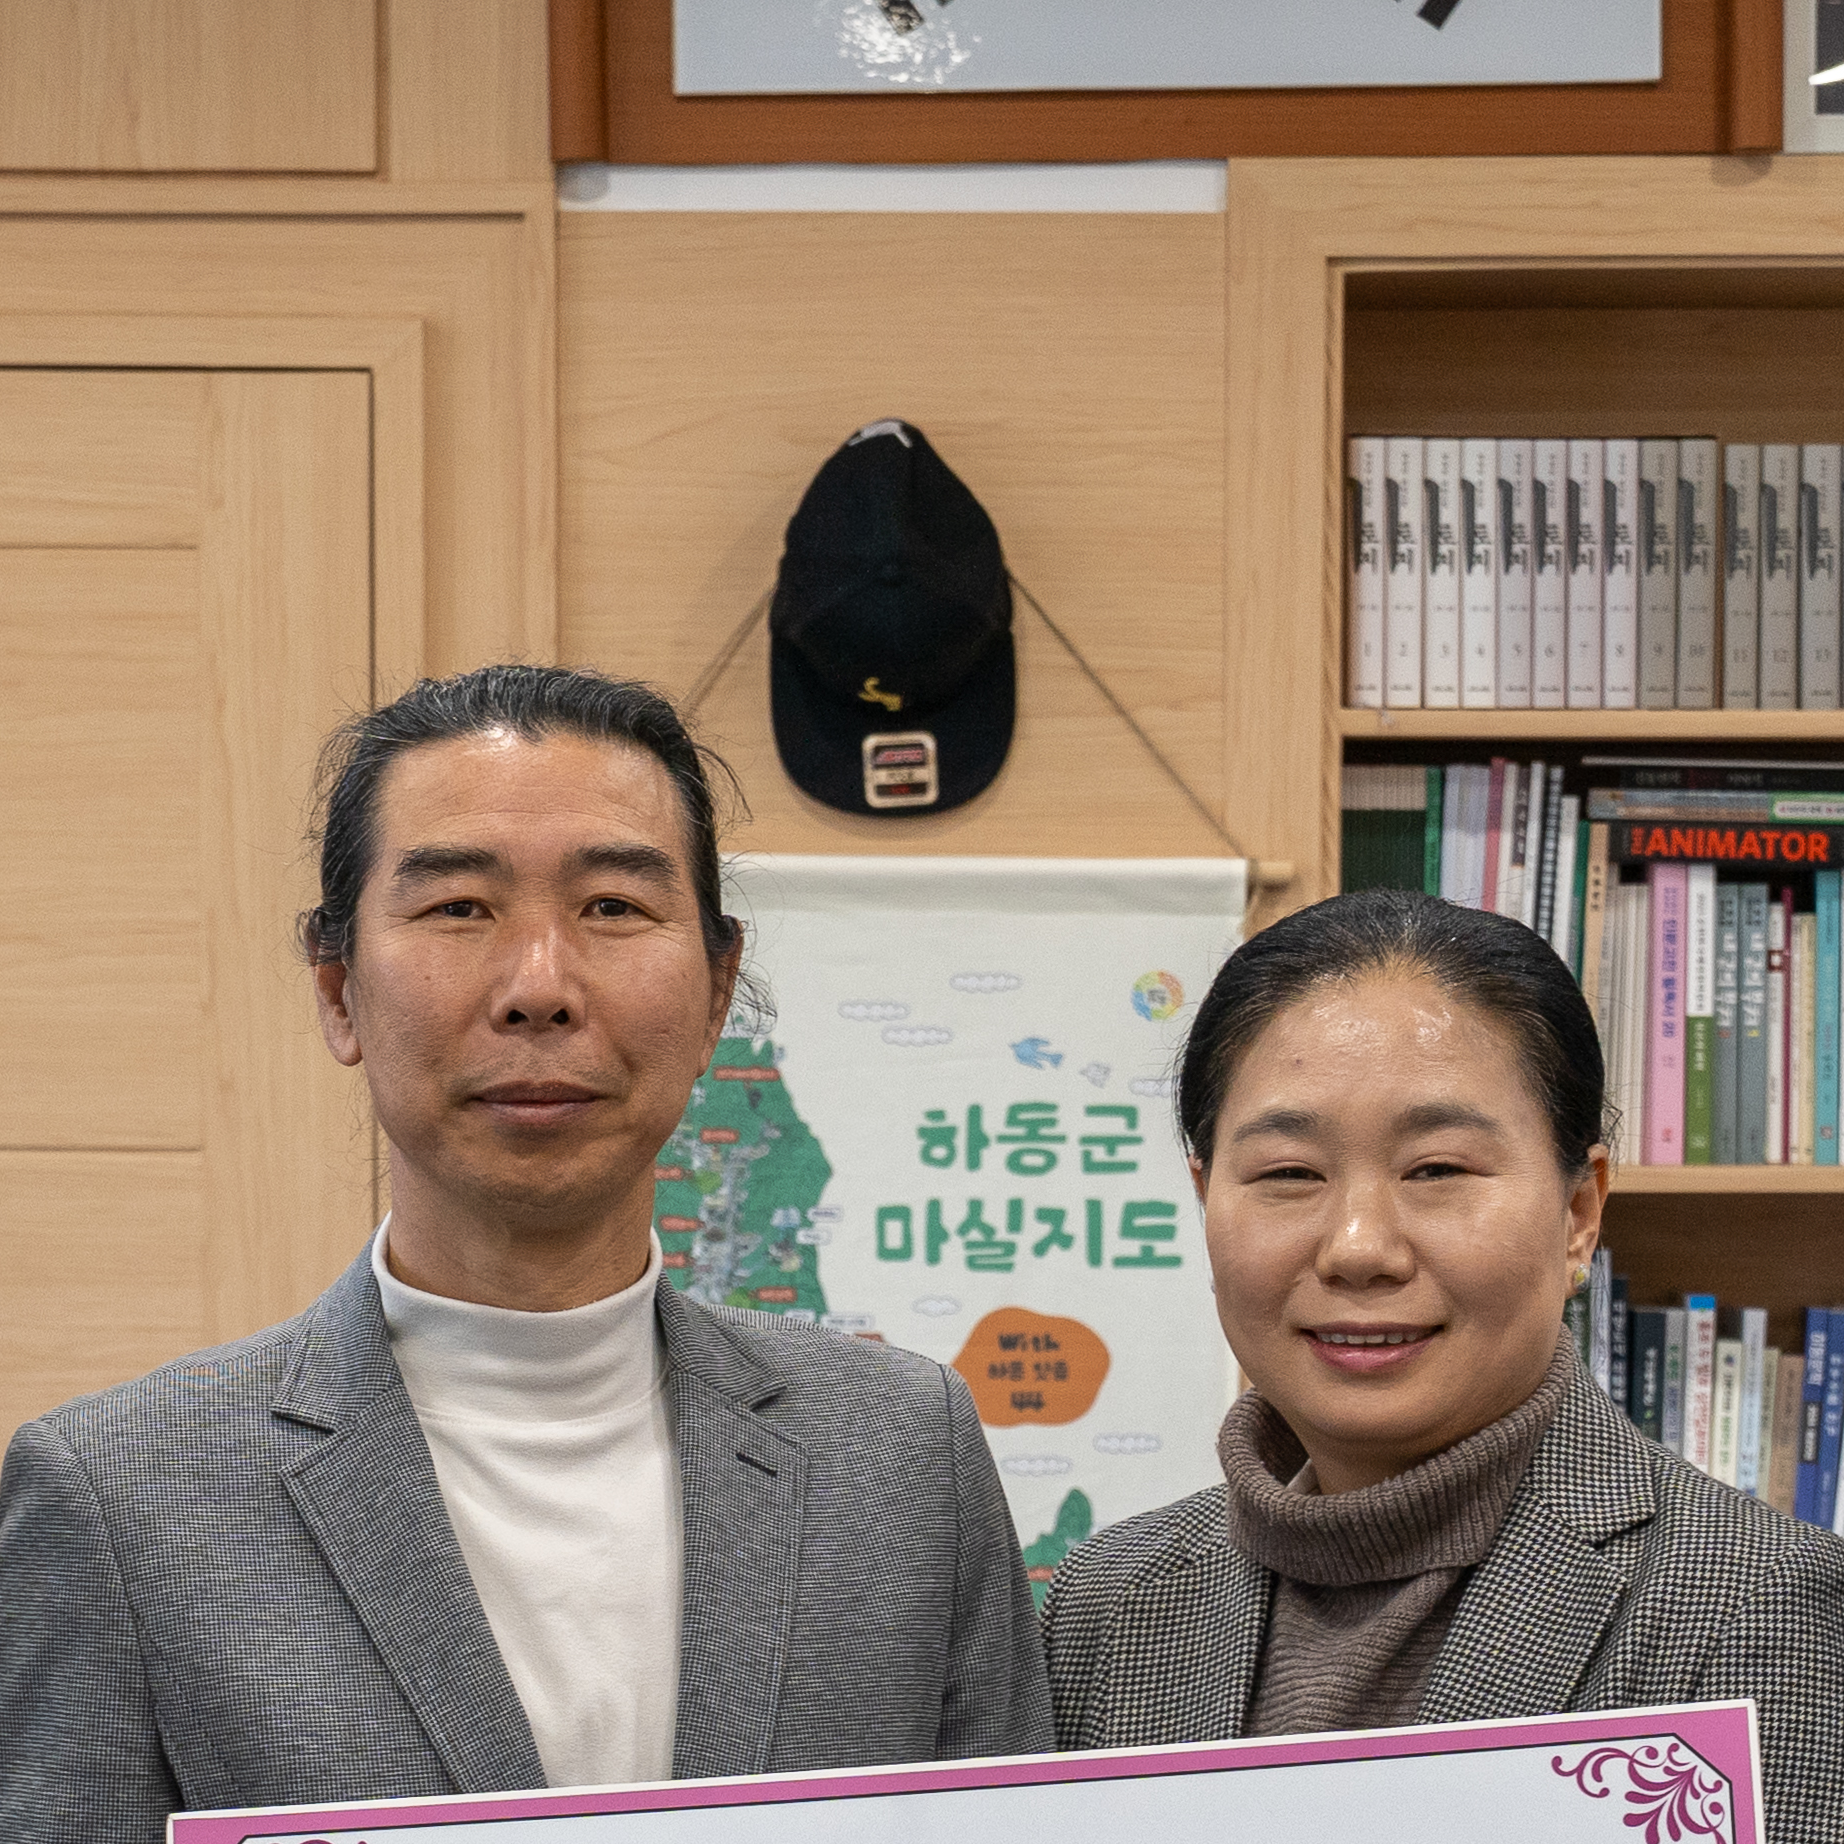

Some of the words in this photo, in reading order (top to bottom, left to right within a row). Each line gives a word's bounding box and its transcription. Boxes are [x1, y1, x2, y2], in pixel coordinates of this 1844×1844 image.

[1645, 828, 1830, 863] ANIMATOR
[1661, 918, 1678, 972] 인문고전
[917, 1102, 1143, 1176] 하동군
[875, 1197, 1183, 1273] 마실지도
[997, 1332, 1060, 1352] With
